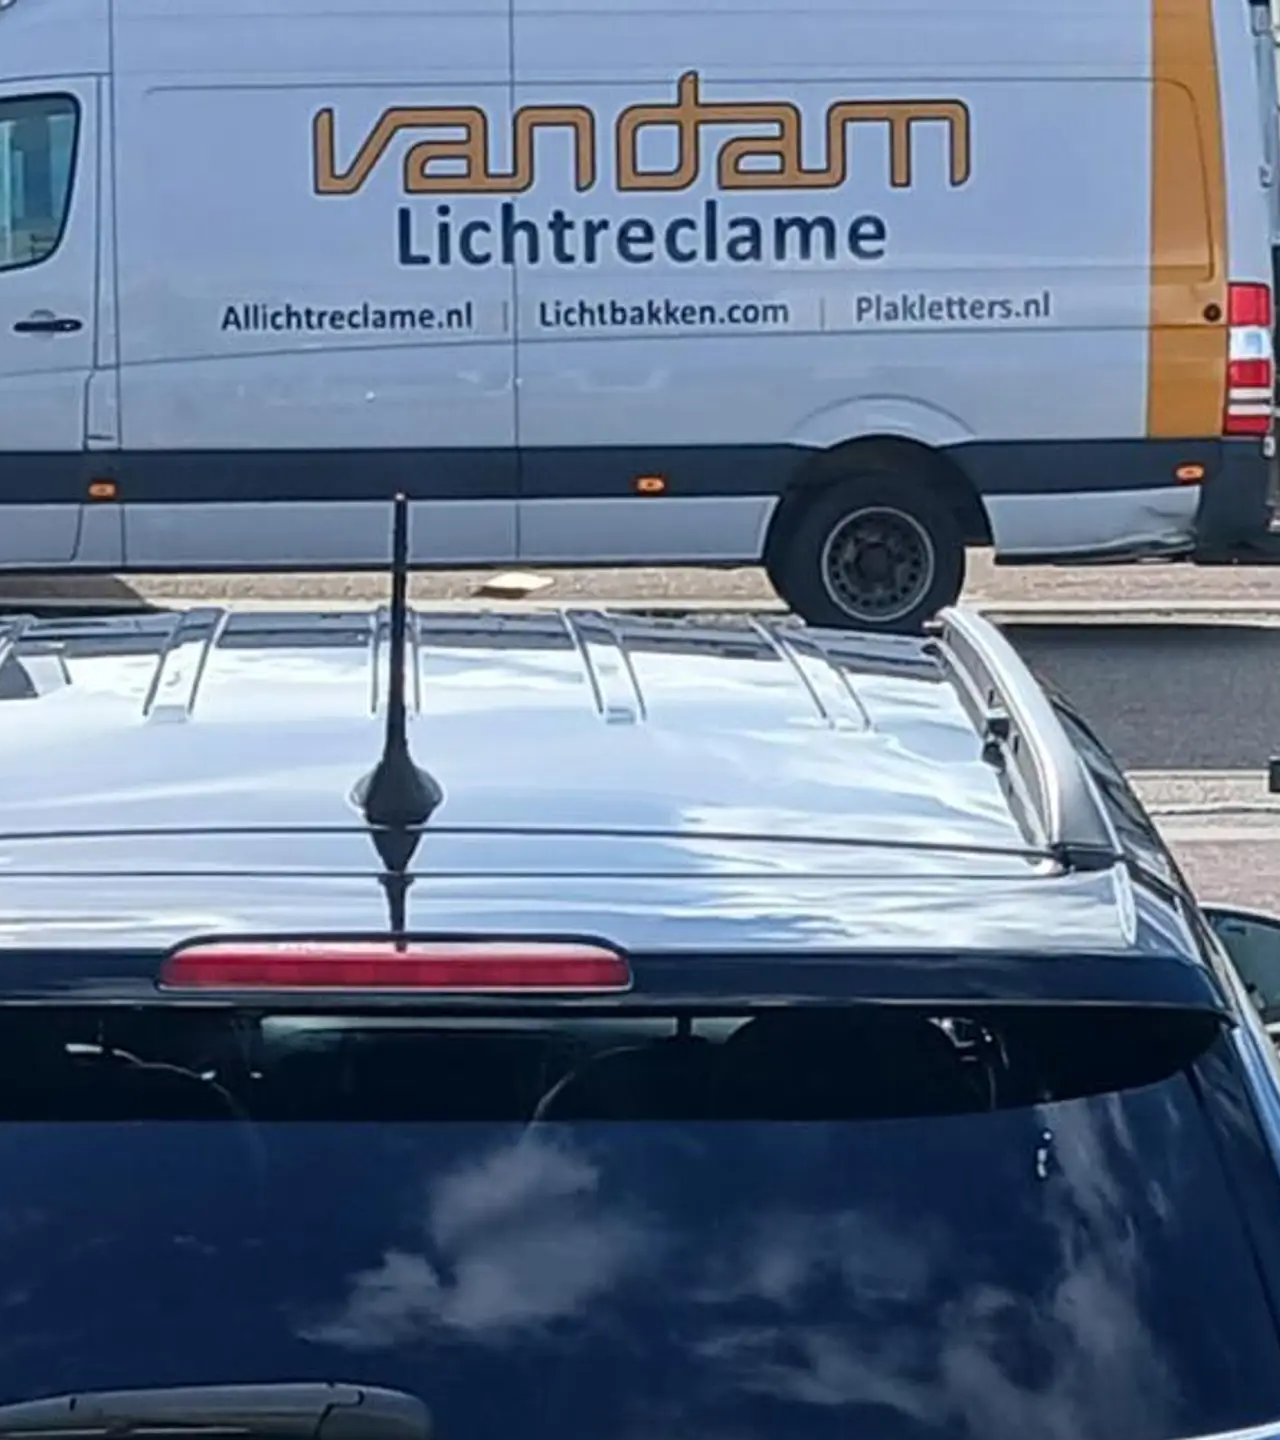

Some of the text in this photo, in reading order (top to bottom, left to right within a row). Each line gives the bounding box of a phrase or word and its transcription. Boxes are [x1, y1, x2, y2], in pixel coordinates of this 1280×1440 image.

[398, 200, 888, 266] Lichtreclame
[220, 292, 1052, 331] Allichtreclame.nl Lichtbakken.com Plakletters.nl
